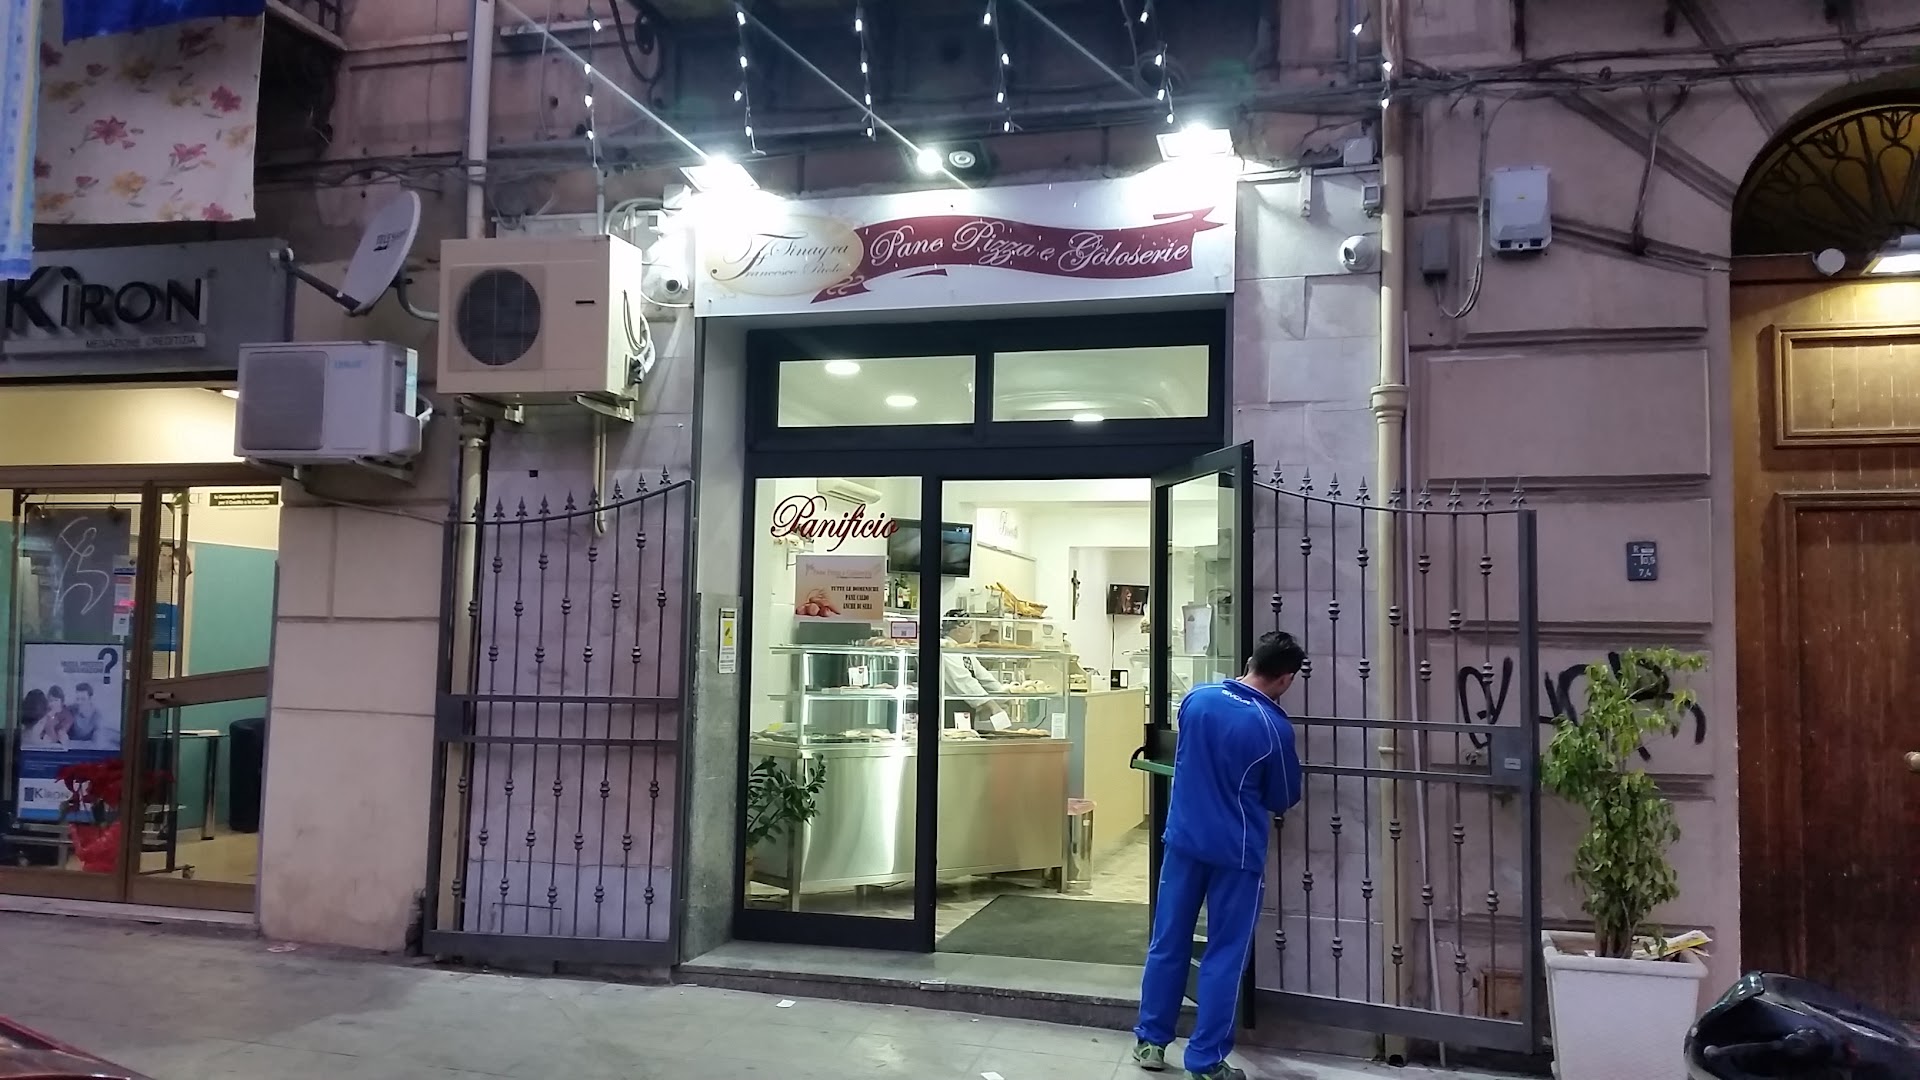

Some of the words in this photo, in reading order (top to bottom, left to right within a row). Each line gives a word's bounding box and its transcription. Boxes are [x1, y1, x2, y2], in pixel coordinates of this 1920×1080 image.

[770, 239, 849, 259] Sinagra
[802, 262, 844, 274] Paolo
[869, 225, 944, 266] Pane
[951, 220, 1036, 266] Pizza
[1039, 246, 1055, 261] e
[1057, 231, 1190, 272] Goloserie
[5, 266, 202, 332] KIRON
[770, 495, 899, 552] Panificio
